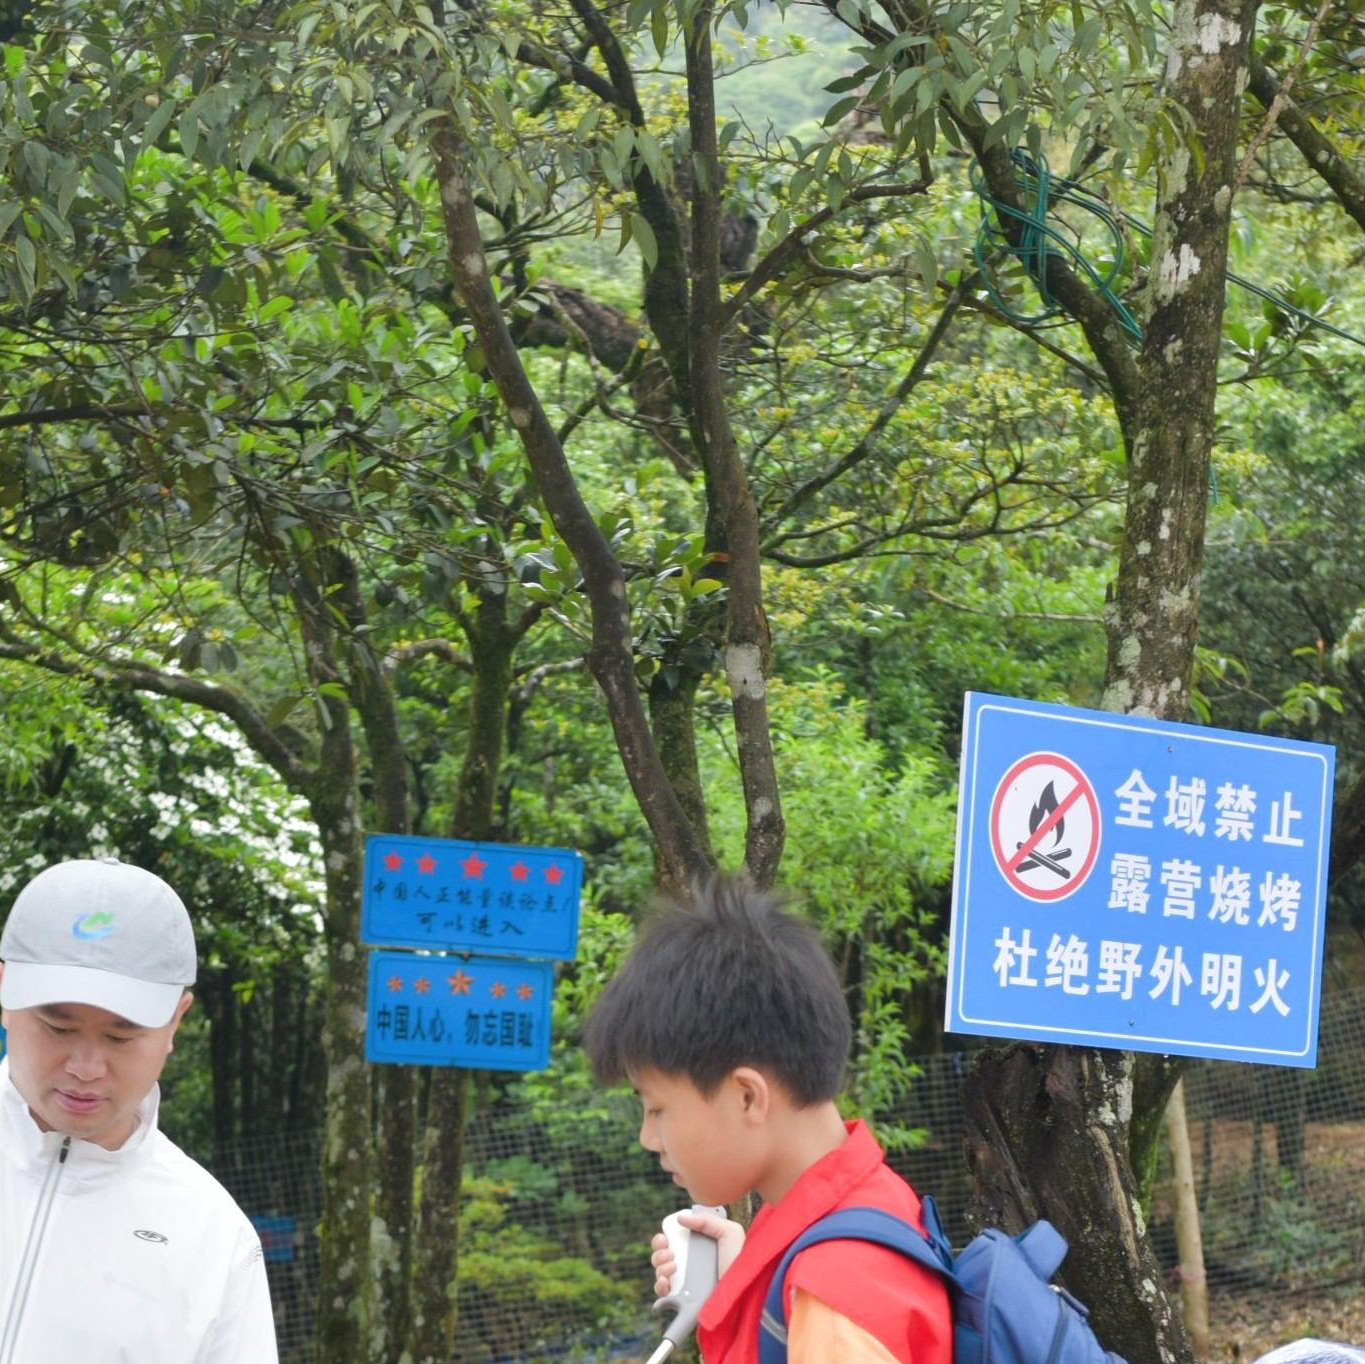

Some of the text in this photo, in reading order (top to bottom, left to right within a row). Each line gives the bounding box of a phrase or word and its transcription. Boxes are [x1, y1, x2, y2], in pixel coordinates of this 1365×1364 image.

[1114, 768, 1305, 848] 全域禁止
[416, 911, 524, 937] 可以进入
[1107, 852, 1302, 932] 露营烧烤
[992, 926, 1291, 1017] 杜绝野外明火
